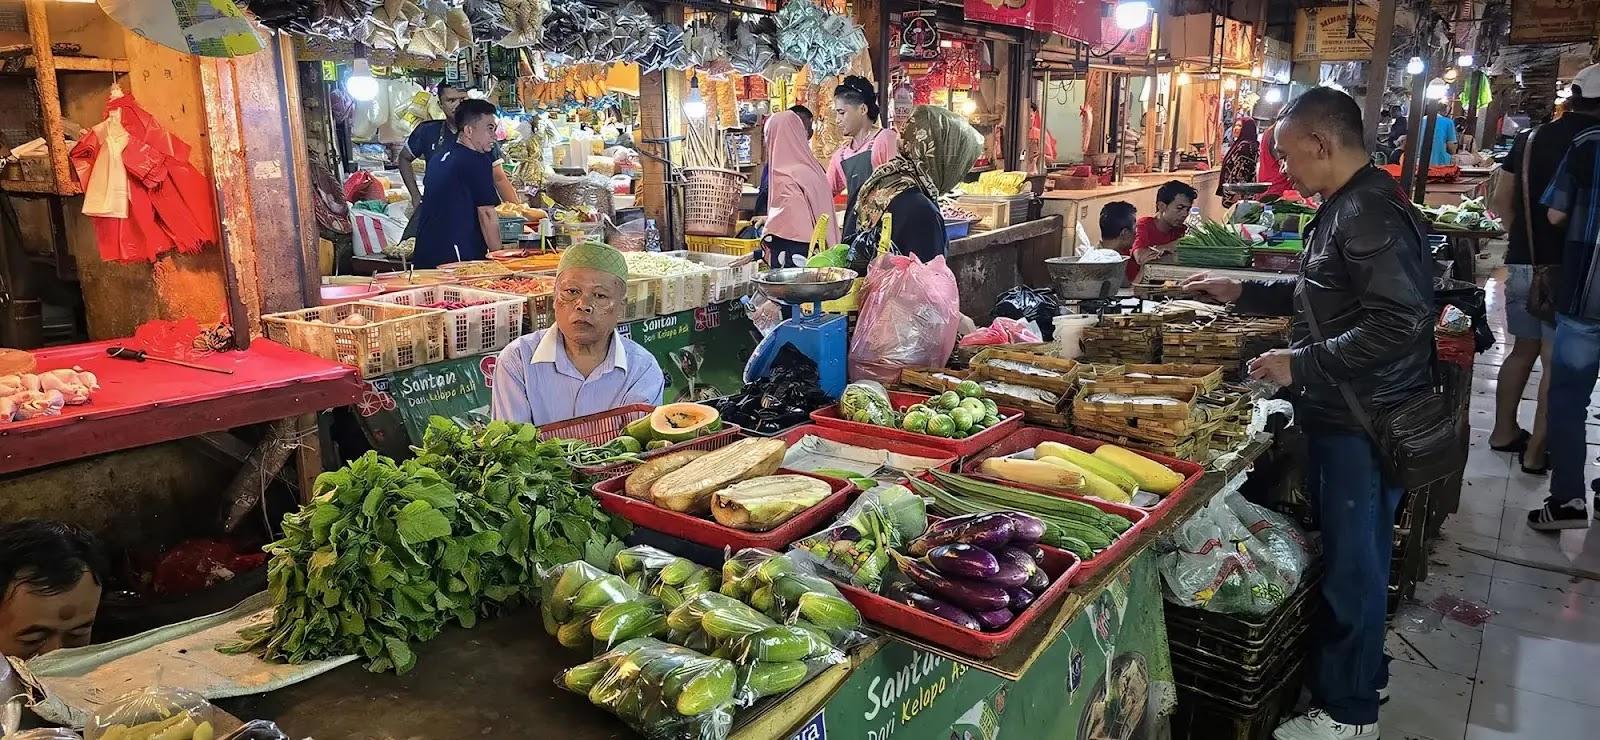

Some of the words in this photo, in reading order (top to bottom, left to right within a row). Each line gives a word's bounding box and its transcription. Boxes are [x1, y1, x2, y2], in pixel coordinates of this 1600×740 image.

[642, 315, 677, 333] Santan
[401, 372, 456, 395] Santan
[459, 380, 476, 395] Asli
[901, 676, 946, 725] Kelapa
